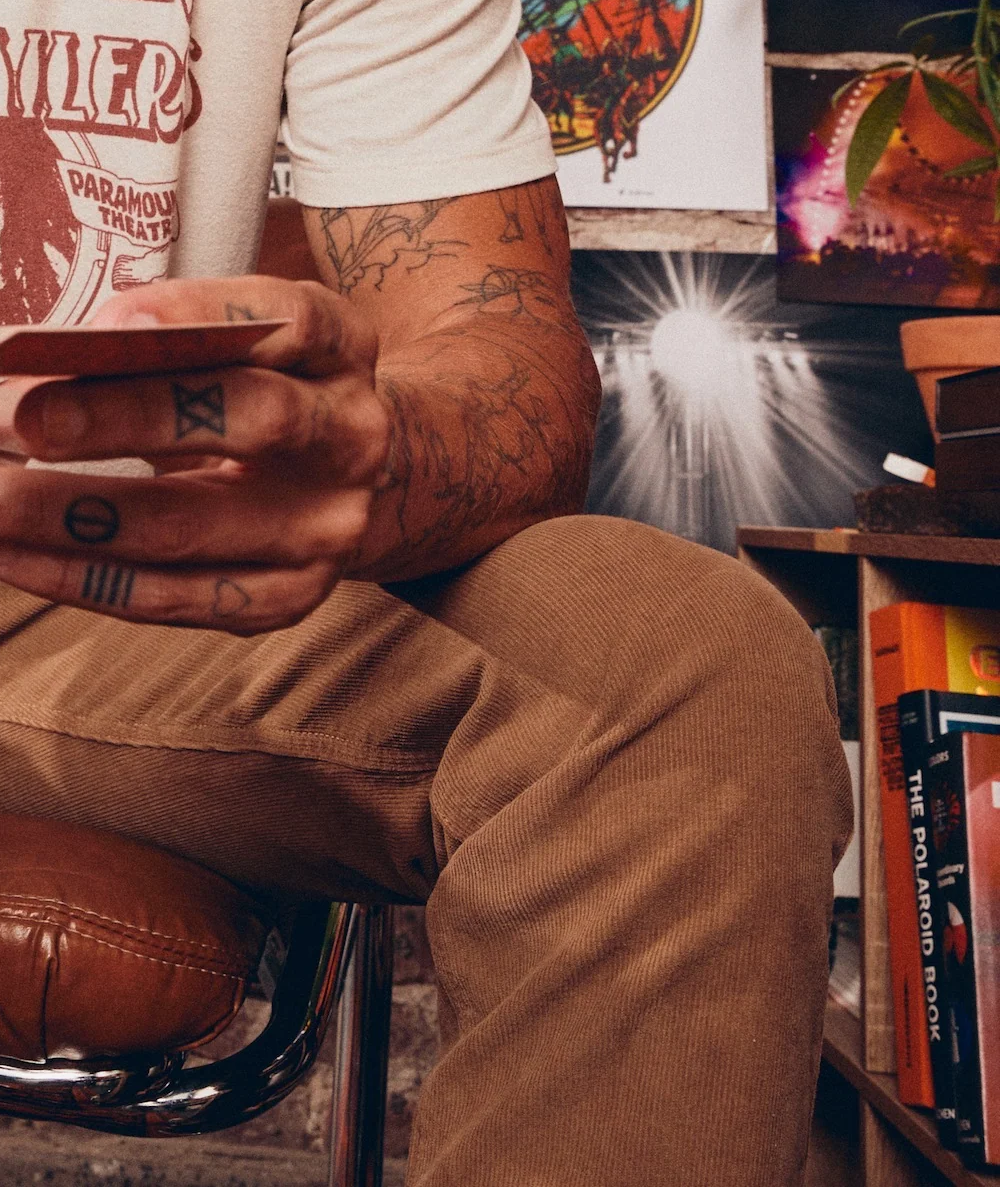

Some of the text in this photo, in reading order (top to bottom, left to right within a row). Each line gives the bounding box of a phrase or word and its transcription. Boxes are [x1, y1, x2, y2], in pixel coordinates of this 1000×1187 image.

[908, 769, 941, 1042] THE POLAROID BOOK
